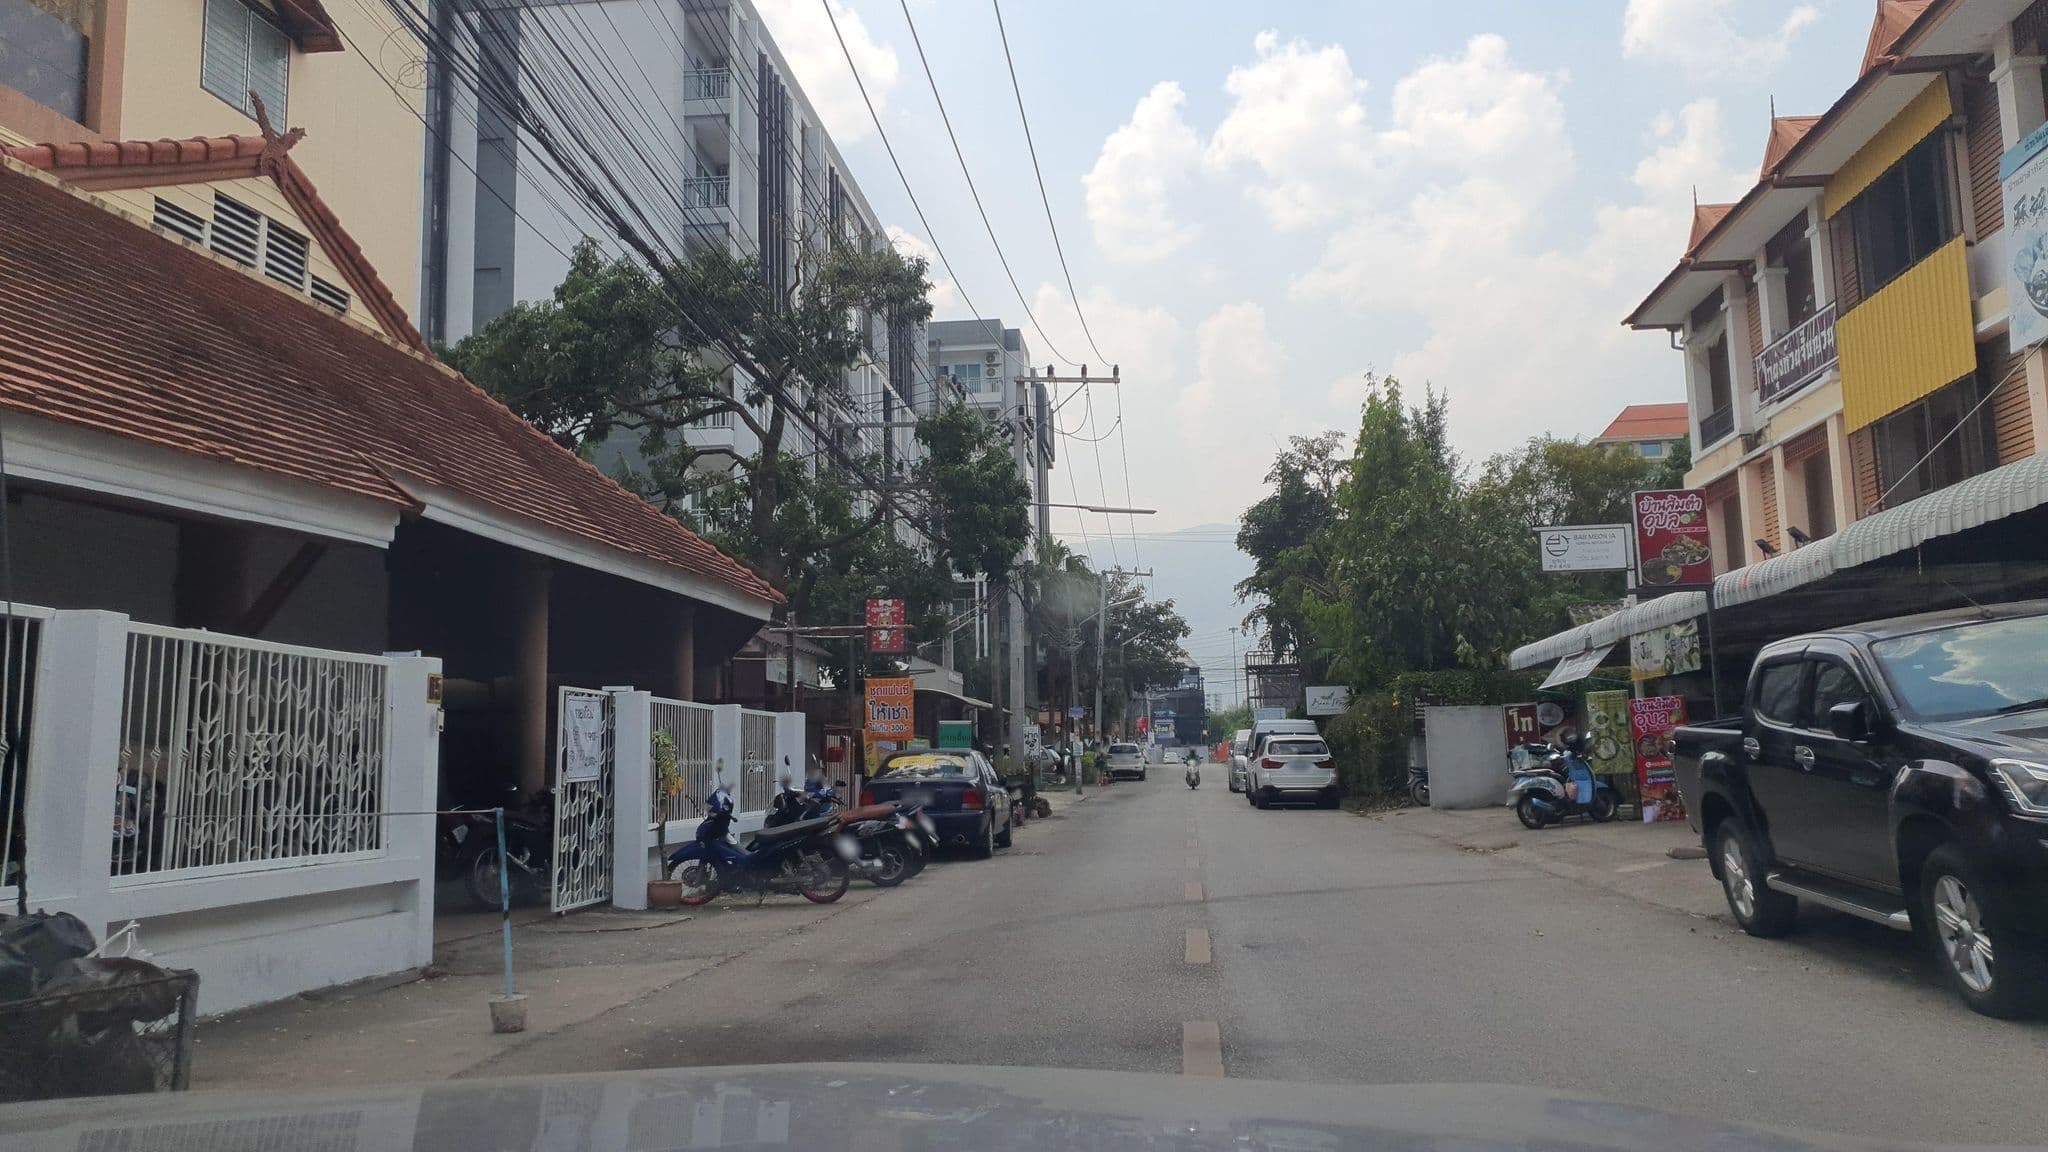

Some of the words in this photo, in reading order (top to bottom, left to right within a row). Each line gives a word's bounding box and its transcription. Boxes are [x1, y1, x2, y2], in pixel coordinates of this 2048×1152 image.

[1639, 494, 1703, 513] บ้านส้มตำ
[1643, 512, 1680, 537] อุบล
[869, 699, 908, 721] ให้เช่า
[1635, 711, 1669, 733] อุบล
